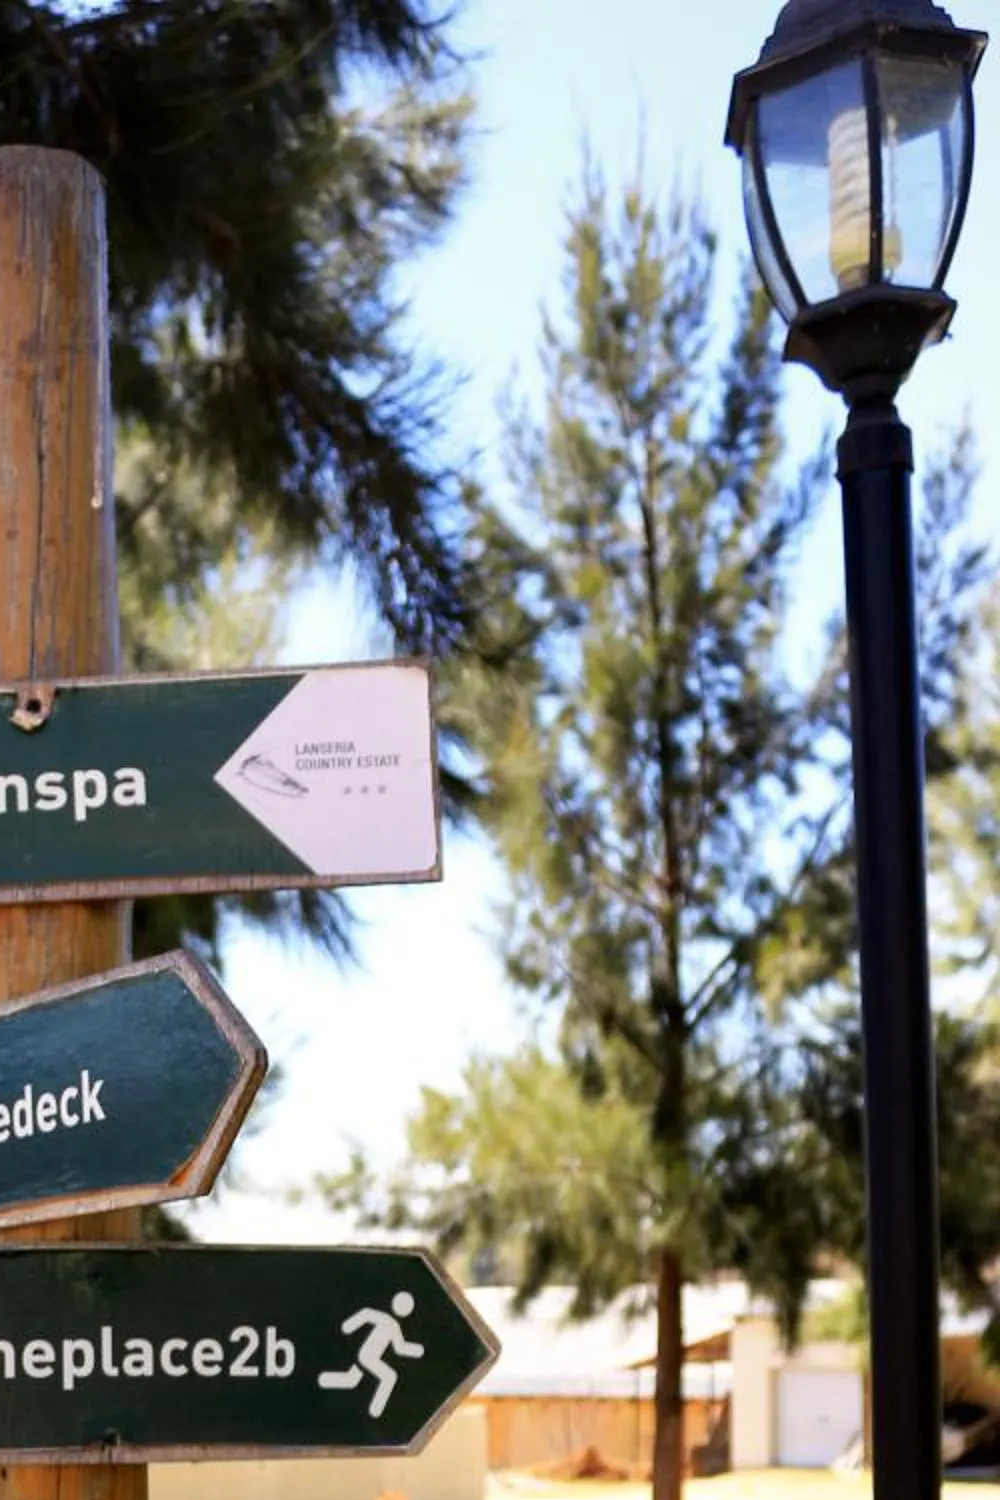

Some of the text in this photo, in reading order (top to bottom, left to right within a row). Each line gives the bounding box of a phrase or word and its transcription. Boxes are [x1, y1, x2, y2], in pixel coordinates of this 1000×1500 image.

[294, 741, 357, 756] LANSERIA
[295, 753, 401, 771] COUNTRY ESTATE
